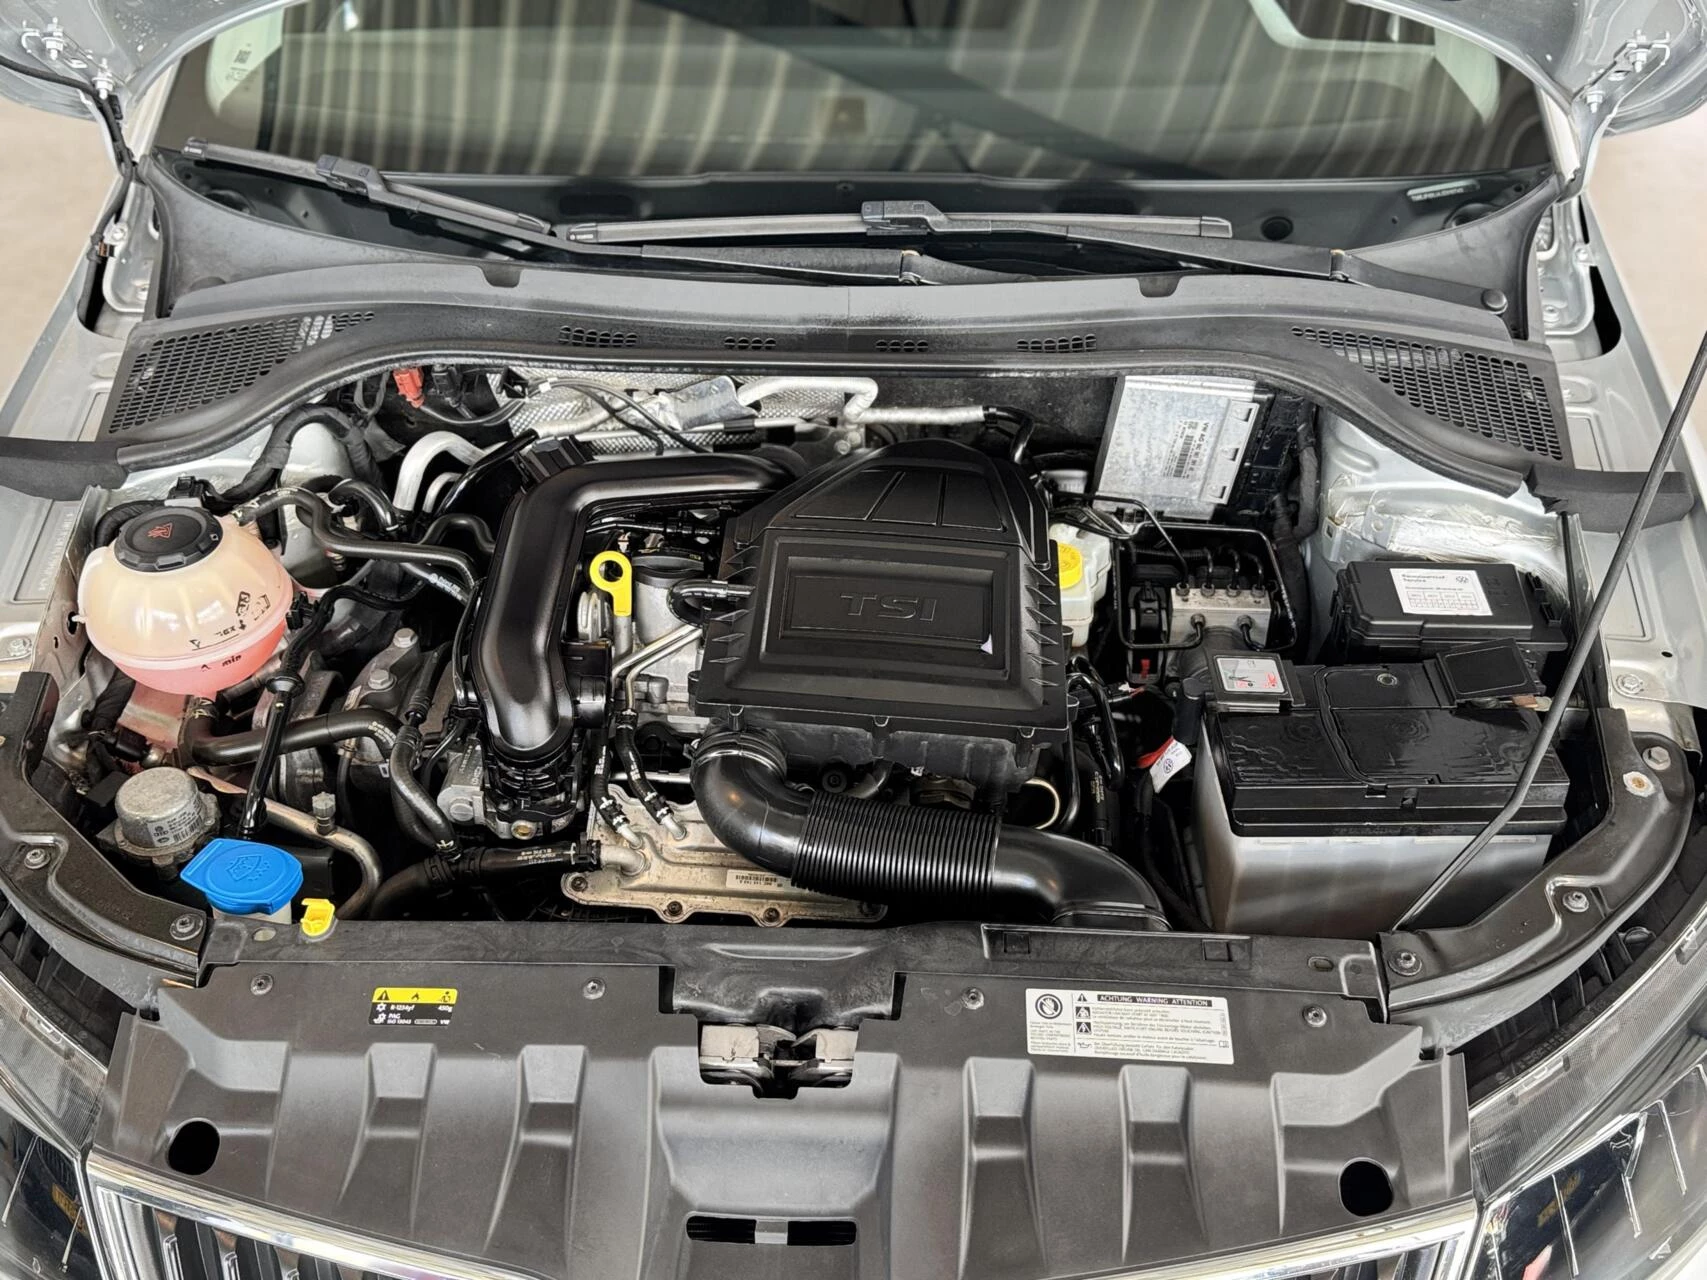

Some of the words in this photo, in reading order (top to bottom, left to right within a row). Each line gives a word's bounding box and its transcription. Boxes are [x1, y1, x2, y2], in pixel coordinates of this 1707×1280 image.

[840, 593, 938, 622] TSI
[222, 654, 242, 667] min
[1099, 995, 1133, 1003] ACHTUNG
[1136, 997, 1169, 1005] WARNING
[1171, 999, 1209, 1007] ATTENTION
